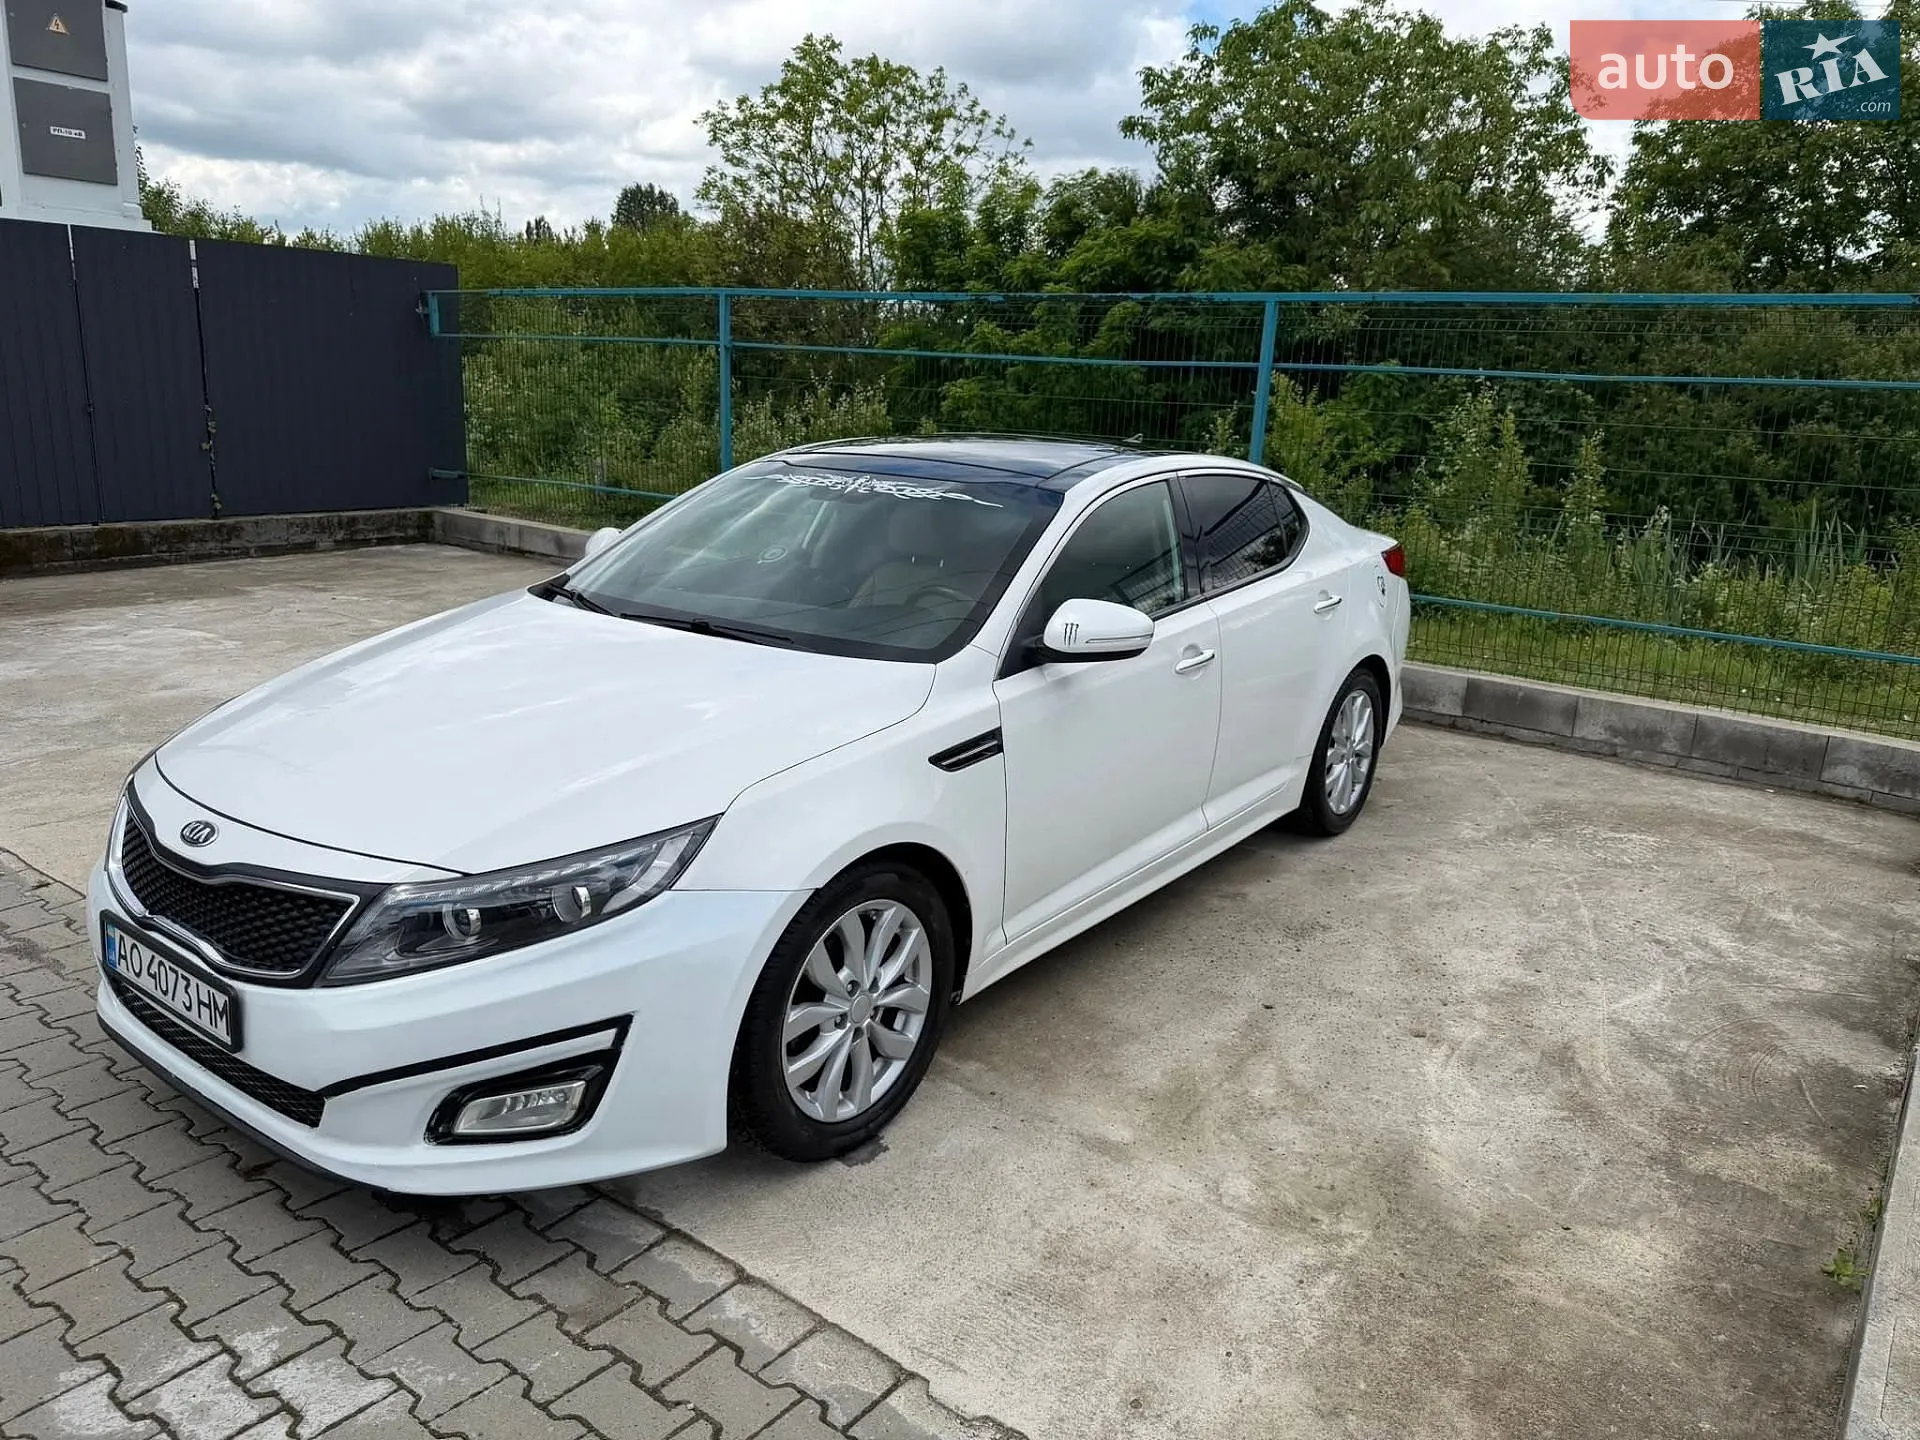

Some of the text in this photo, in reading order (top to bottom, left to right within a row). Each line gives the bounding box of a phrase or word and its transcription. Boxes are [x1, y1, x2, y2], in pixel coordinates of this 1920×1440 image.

[118, 933, 231, 1037] AO 4073 HM
